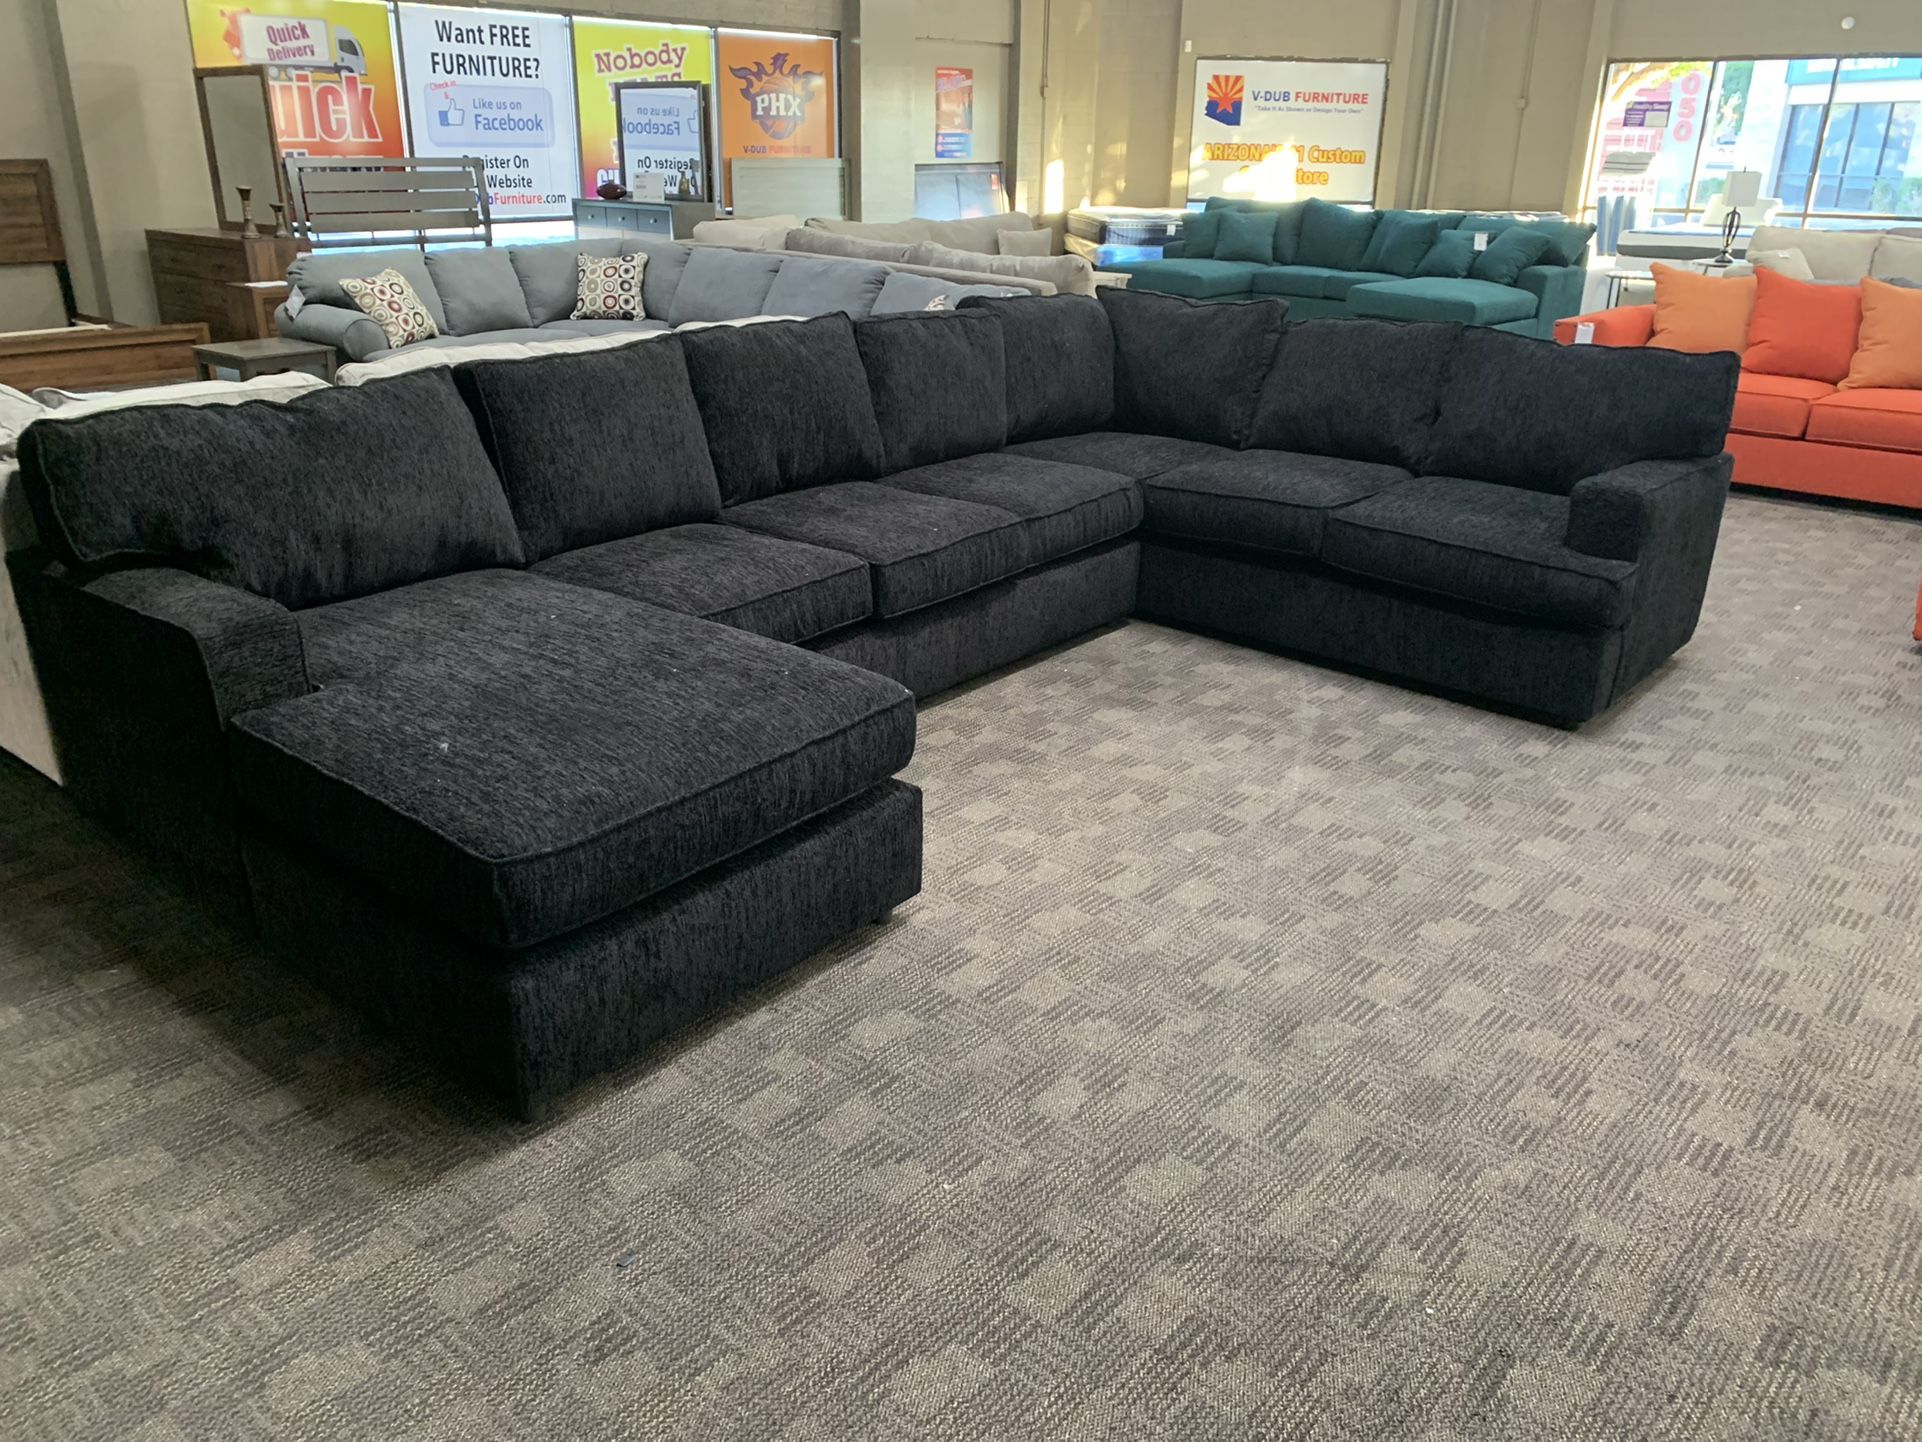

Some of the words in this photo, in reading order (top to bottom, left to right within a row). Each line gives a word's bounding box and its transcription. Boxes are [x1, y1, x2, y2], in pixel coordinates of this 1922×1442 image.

[266, 21, 310, 45] Quick
[435, 20, 485, 45] Want
[488, 24, 531, 48] FREE
[267, 44, 315, 61] Delivery
[594, 42, 687, 73] Nobody
[431, 52, 540, 79] FURNITURE?
[268, 70, 382, 142] uick
[472, 98, 494, 110] Like
[496, 101, 508, 110] us
[509, 101, 522, 111] on
[755, 93, 801, 116] PHX
[1252, 90, 1291, 102] V-DUB
[1295, 91, 1369, 104] FURNITURE
[475, 113, 544, 132] Facebook
[513, 155, 530, 169] On
[1308, 145, 1367, 164] Custom
[486, 174, 533, 188] Website
[1295, 168, 1330, 186] tore
